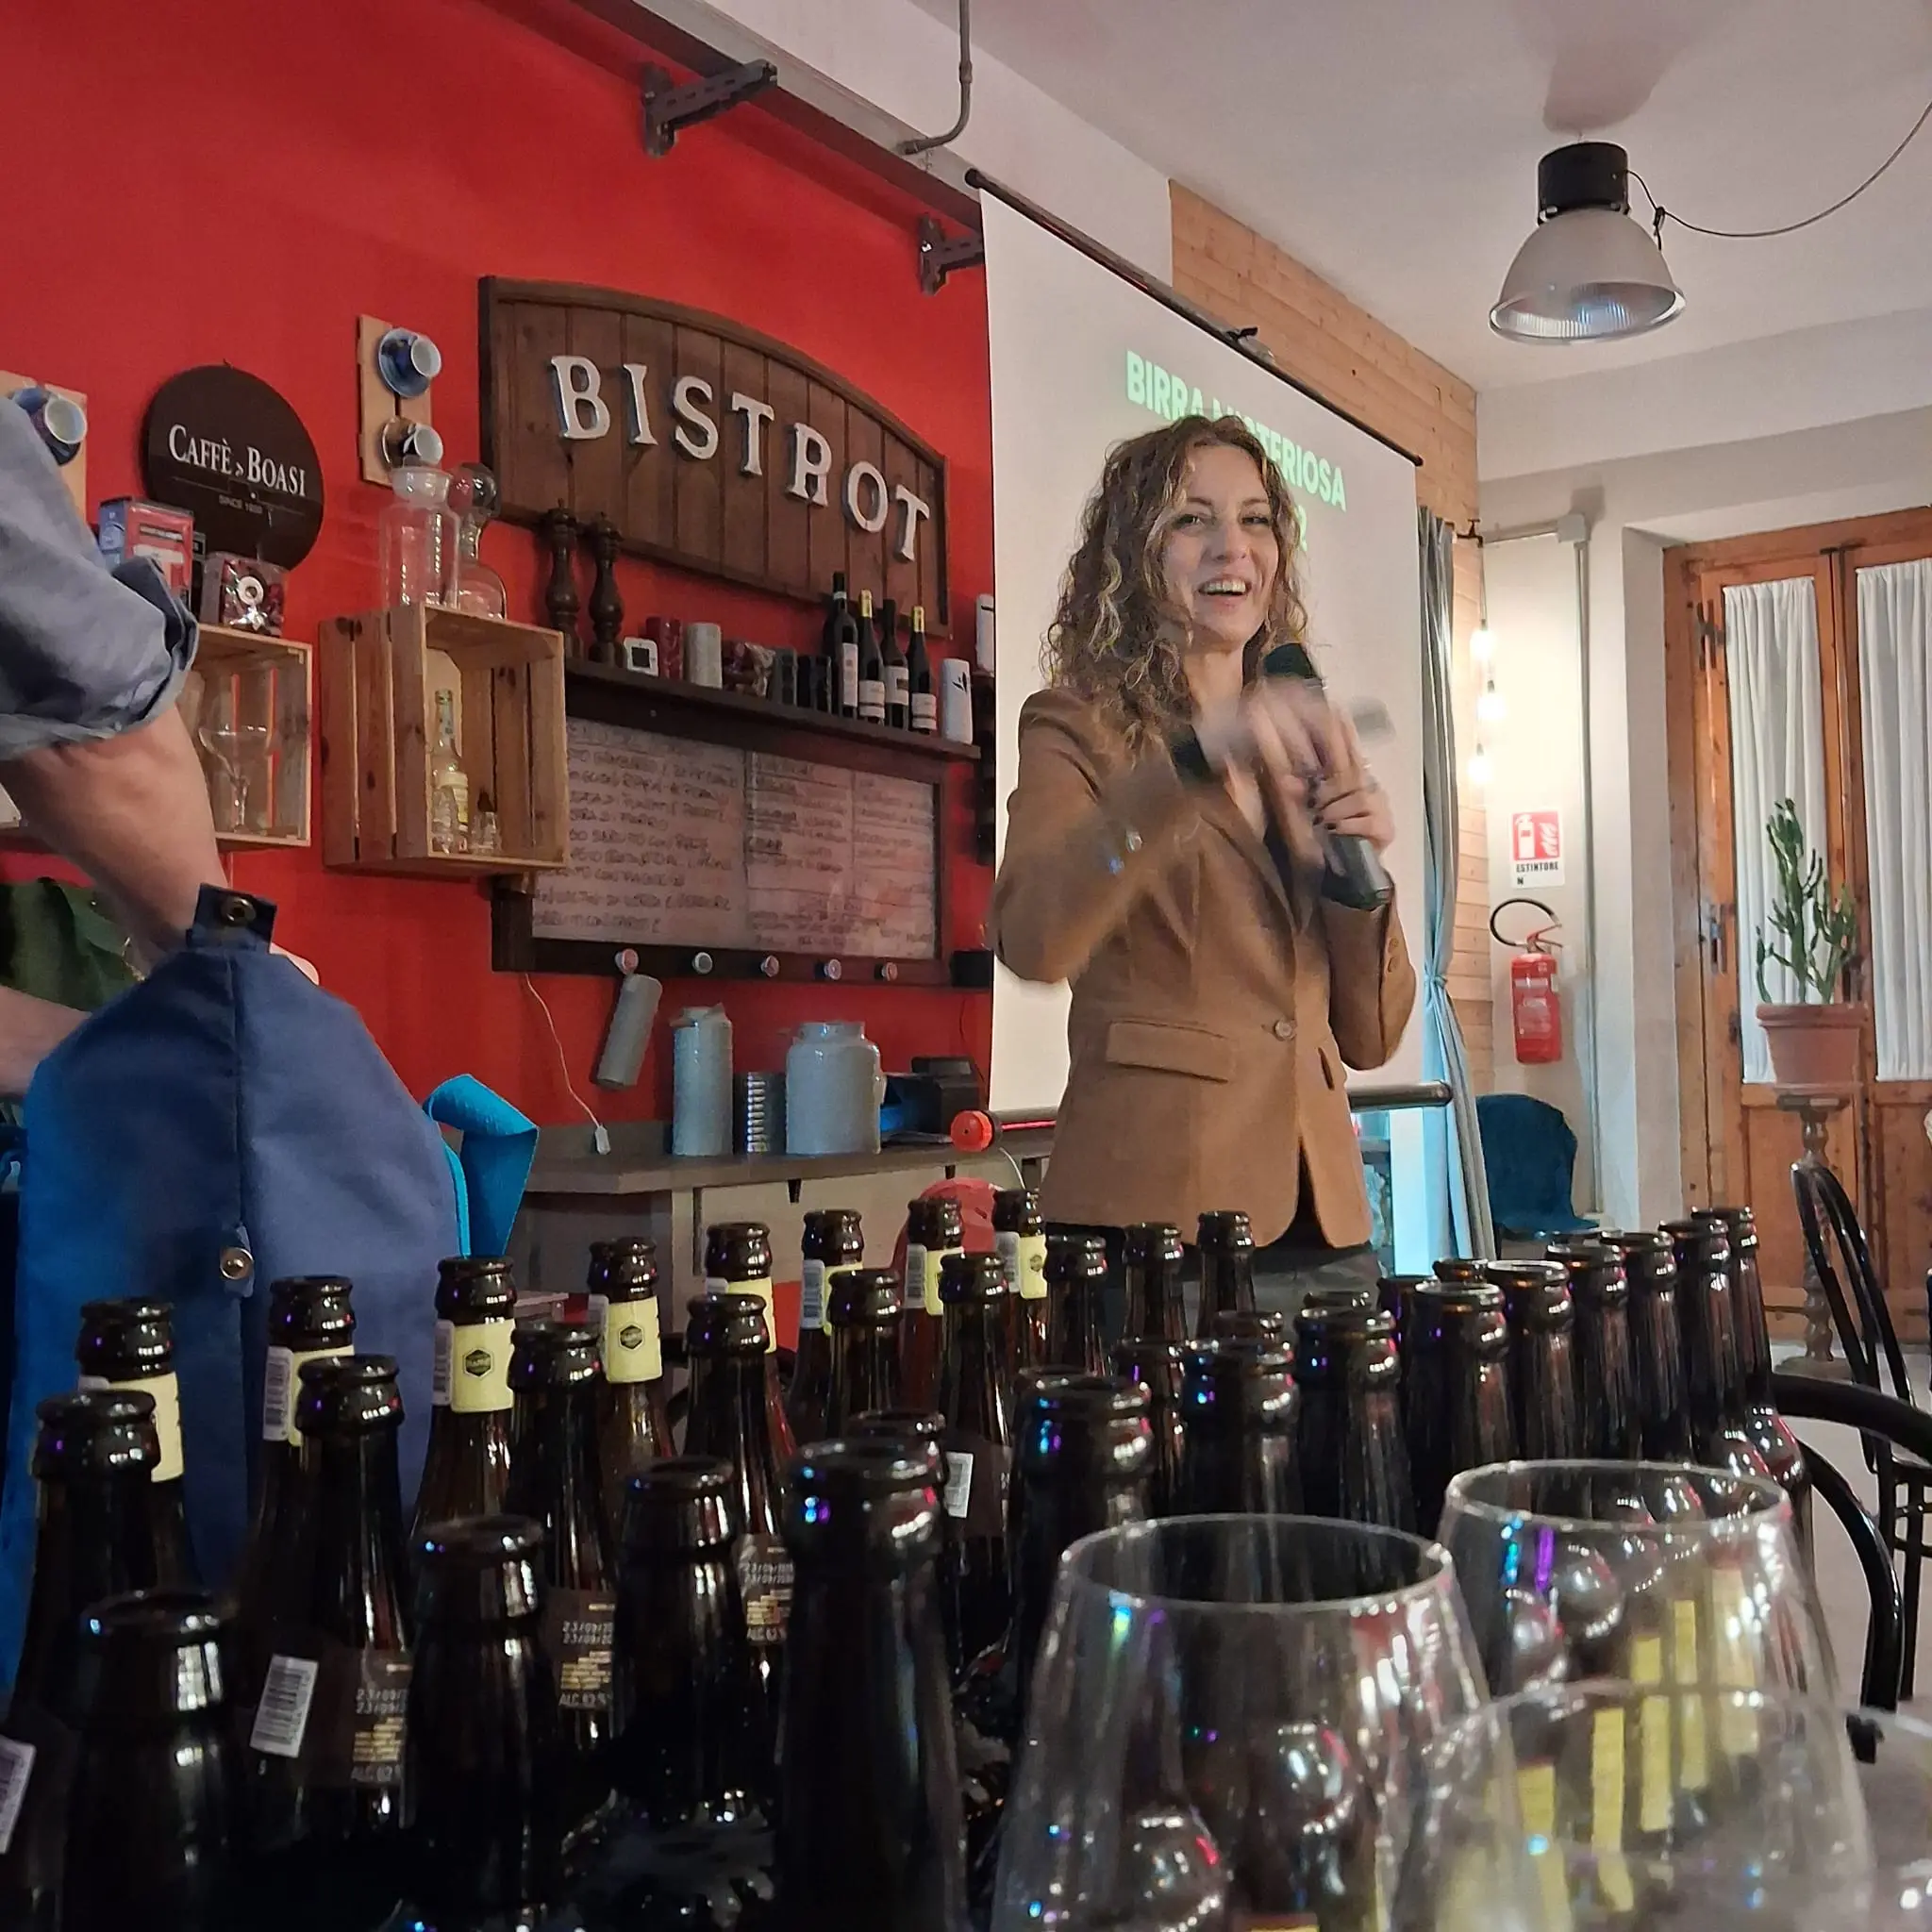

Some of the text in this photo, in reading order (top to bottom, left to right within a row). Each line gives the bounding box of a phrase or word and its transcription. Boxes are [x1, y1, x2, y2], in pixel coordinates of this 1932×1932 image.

[169, 424, 307, 497] CAFFÈ BOASI
[550, 355, 930, 563] BISTROT
[1126, 349, 1347, 512] BIRRA TERIOSA
[1516, 861, 1558, 873] ESTINTORE
